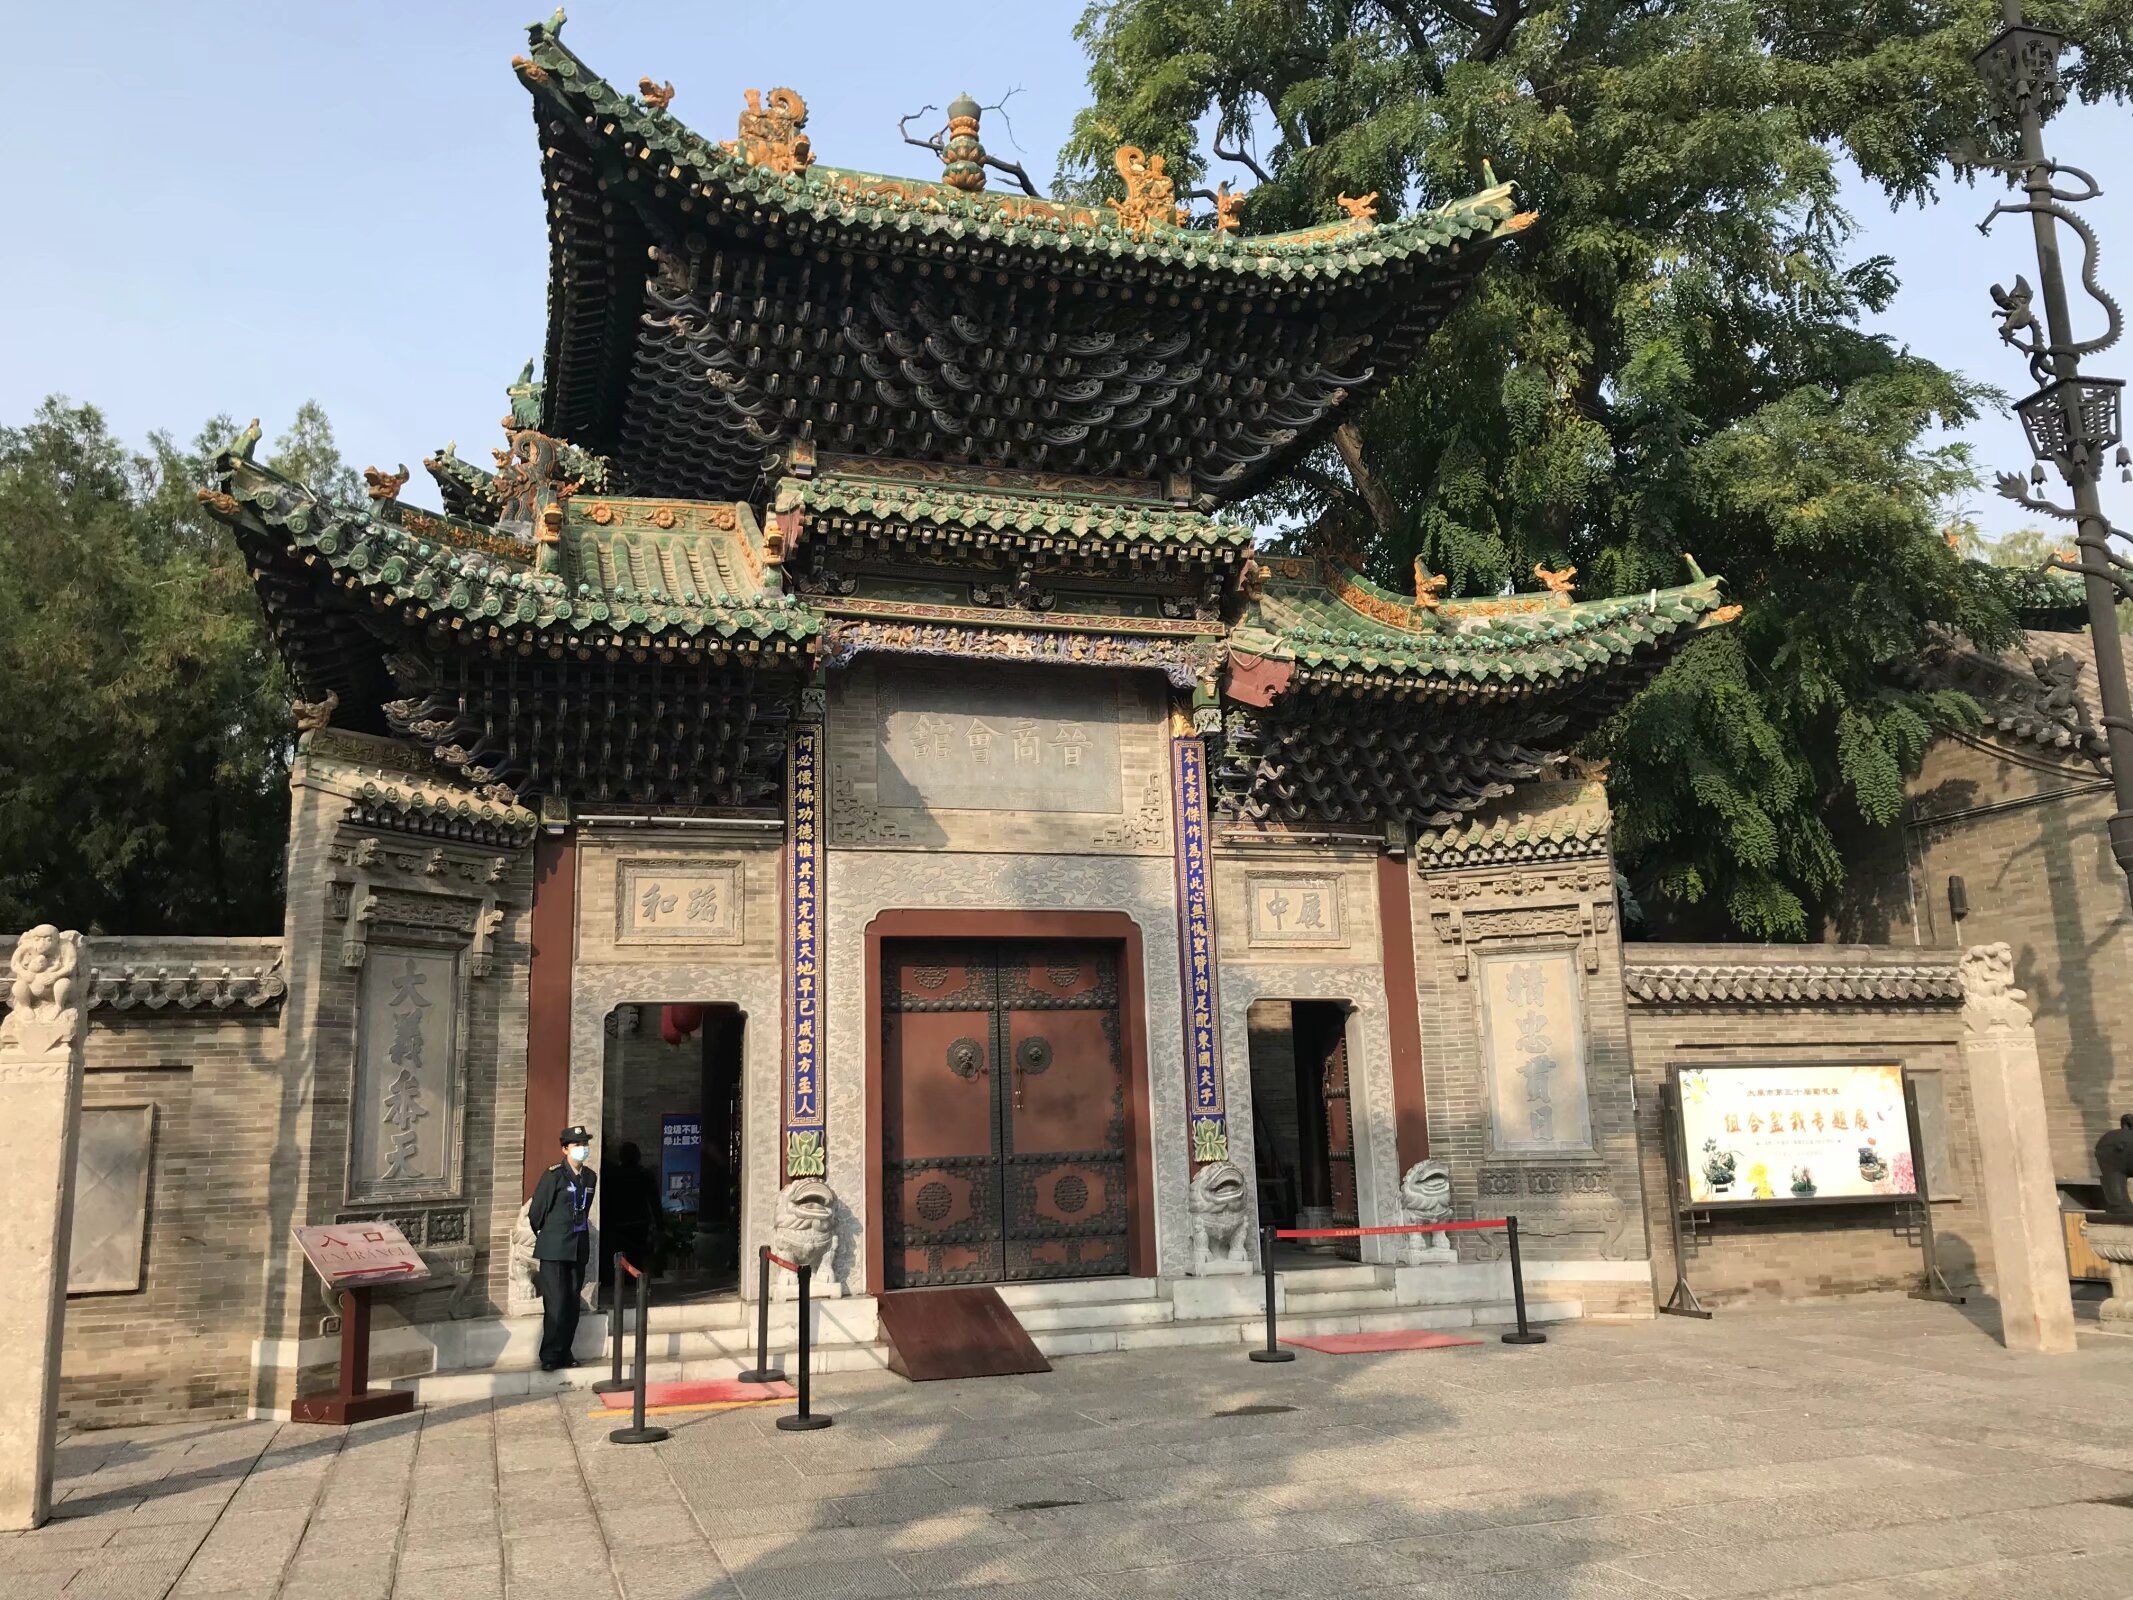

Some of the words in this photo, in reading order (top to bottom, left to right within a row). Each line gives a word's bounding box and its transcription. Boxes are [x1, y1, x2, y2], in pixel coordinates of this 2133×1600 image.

[1724, 1108, 1870, 1134] 组合盆栽专题展
[664, 1124, 702, 1134] 垃圾不乱
[664, 1136, 702, 1145] 举止显文
[321, 1232, 384, 1247] 入口
